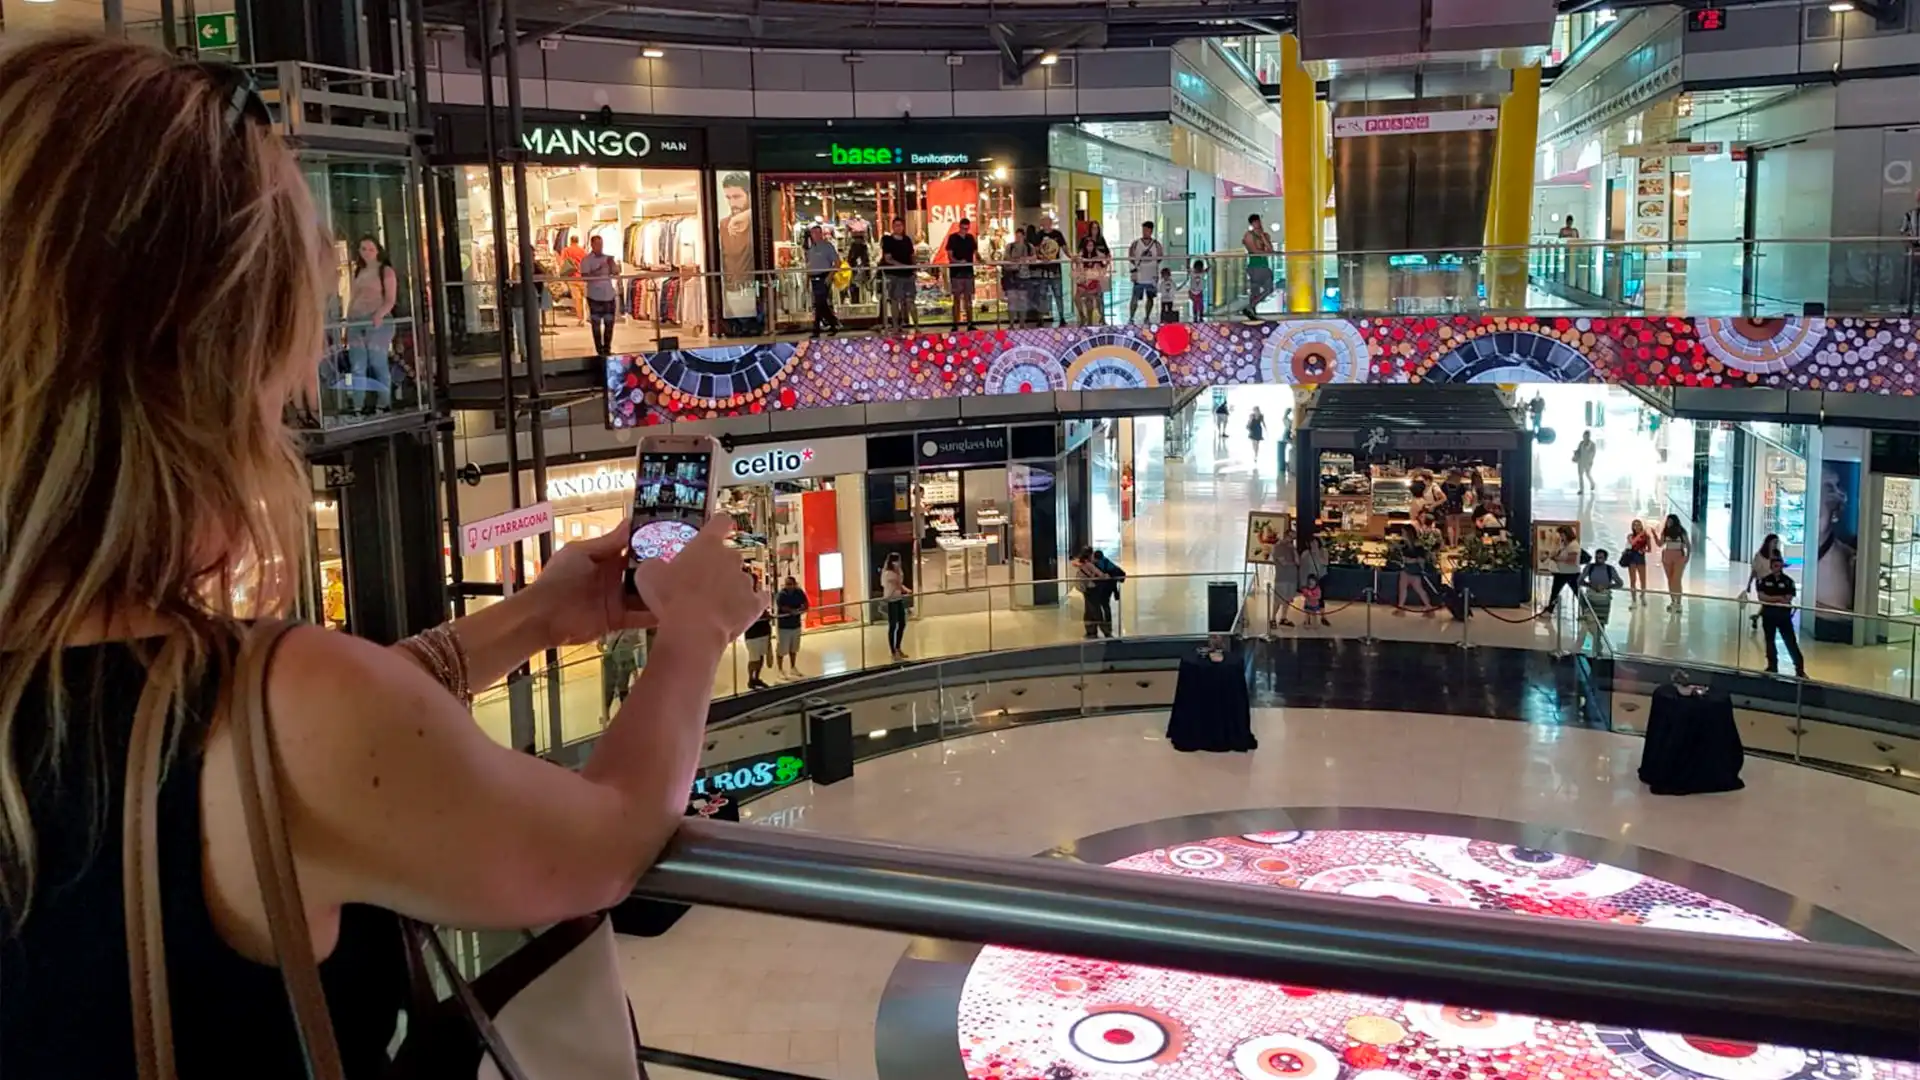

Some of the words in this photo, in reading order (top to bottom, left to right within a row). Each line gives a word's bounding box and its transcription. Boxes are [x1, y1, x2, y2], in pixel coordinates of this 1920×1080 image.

[522, 127, 651, 157] MANGO
[660, 141, 687, 151] MAN
[931, 203, 976, 224] SALE
[938, 437, 985, 453] sunglass
[986, 436, 1004, 449] hut
[494, 511, 548, 537] TARRAGONA
